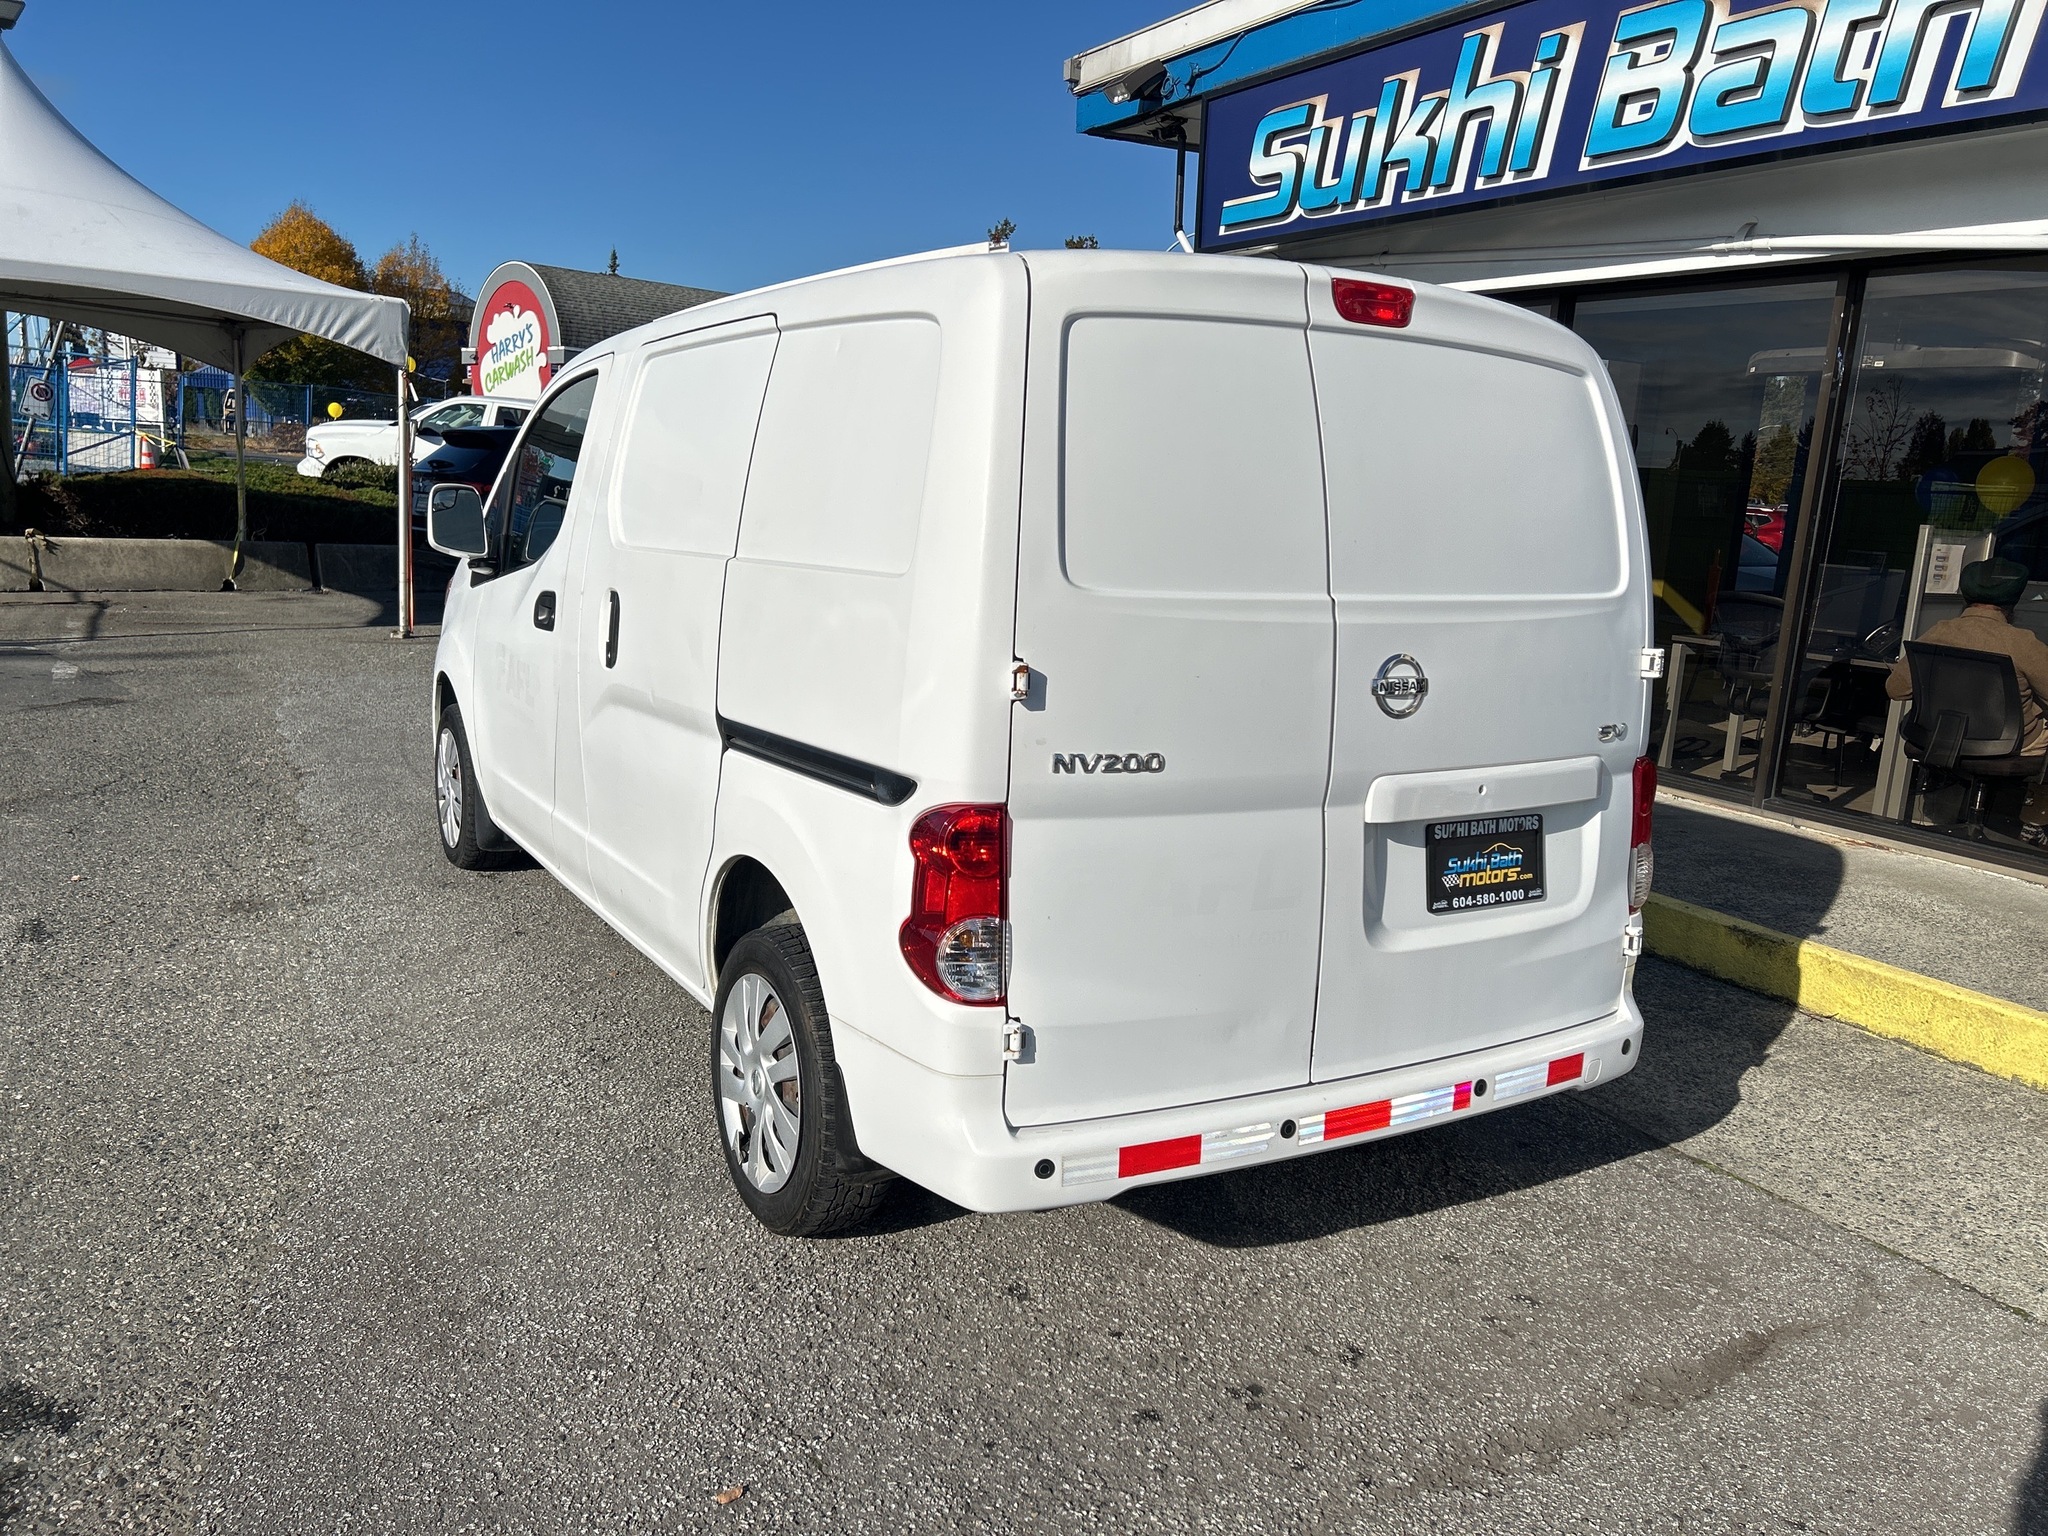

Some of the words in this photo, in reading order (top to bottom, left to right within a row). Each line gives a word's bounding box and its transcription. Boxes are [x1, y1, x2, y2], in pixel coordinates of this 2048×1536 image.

[1220, 21, 1586, 235] Sukhi
[1379, 680, 1425, 693] NISSAN
[1052, 752, 1166, 774] NV200
[1434, 822, 1469, 840] SUKHI
[1470, 819, 1497, 836] BATH
[1444, 851, 1488, 874] Sukhi
[1490, 850, 1523, 868] Bath
[1452, 889, 1524, 908] 604-580-1000
